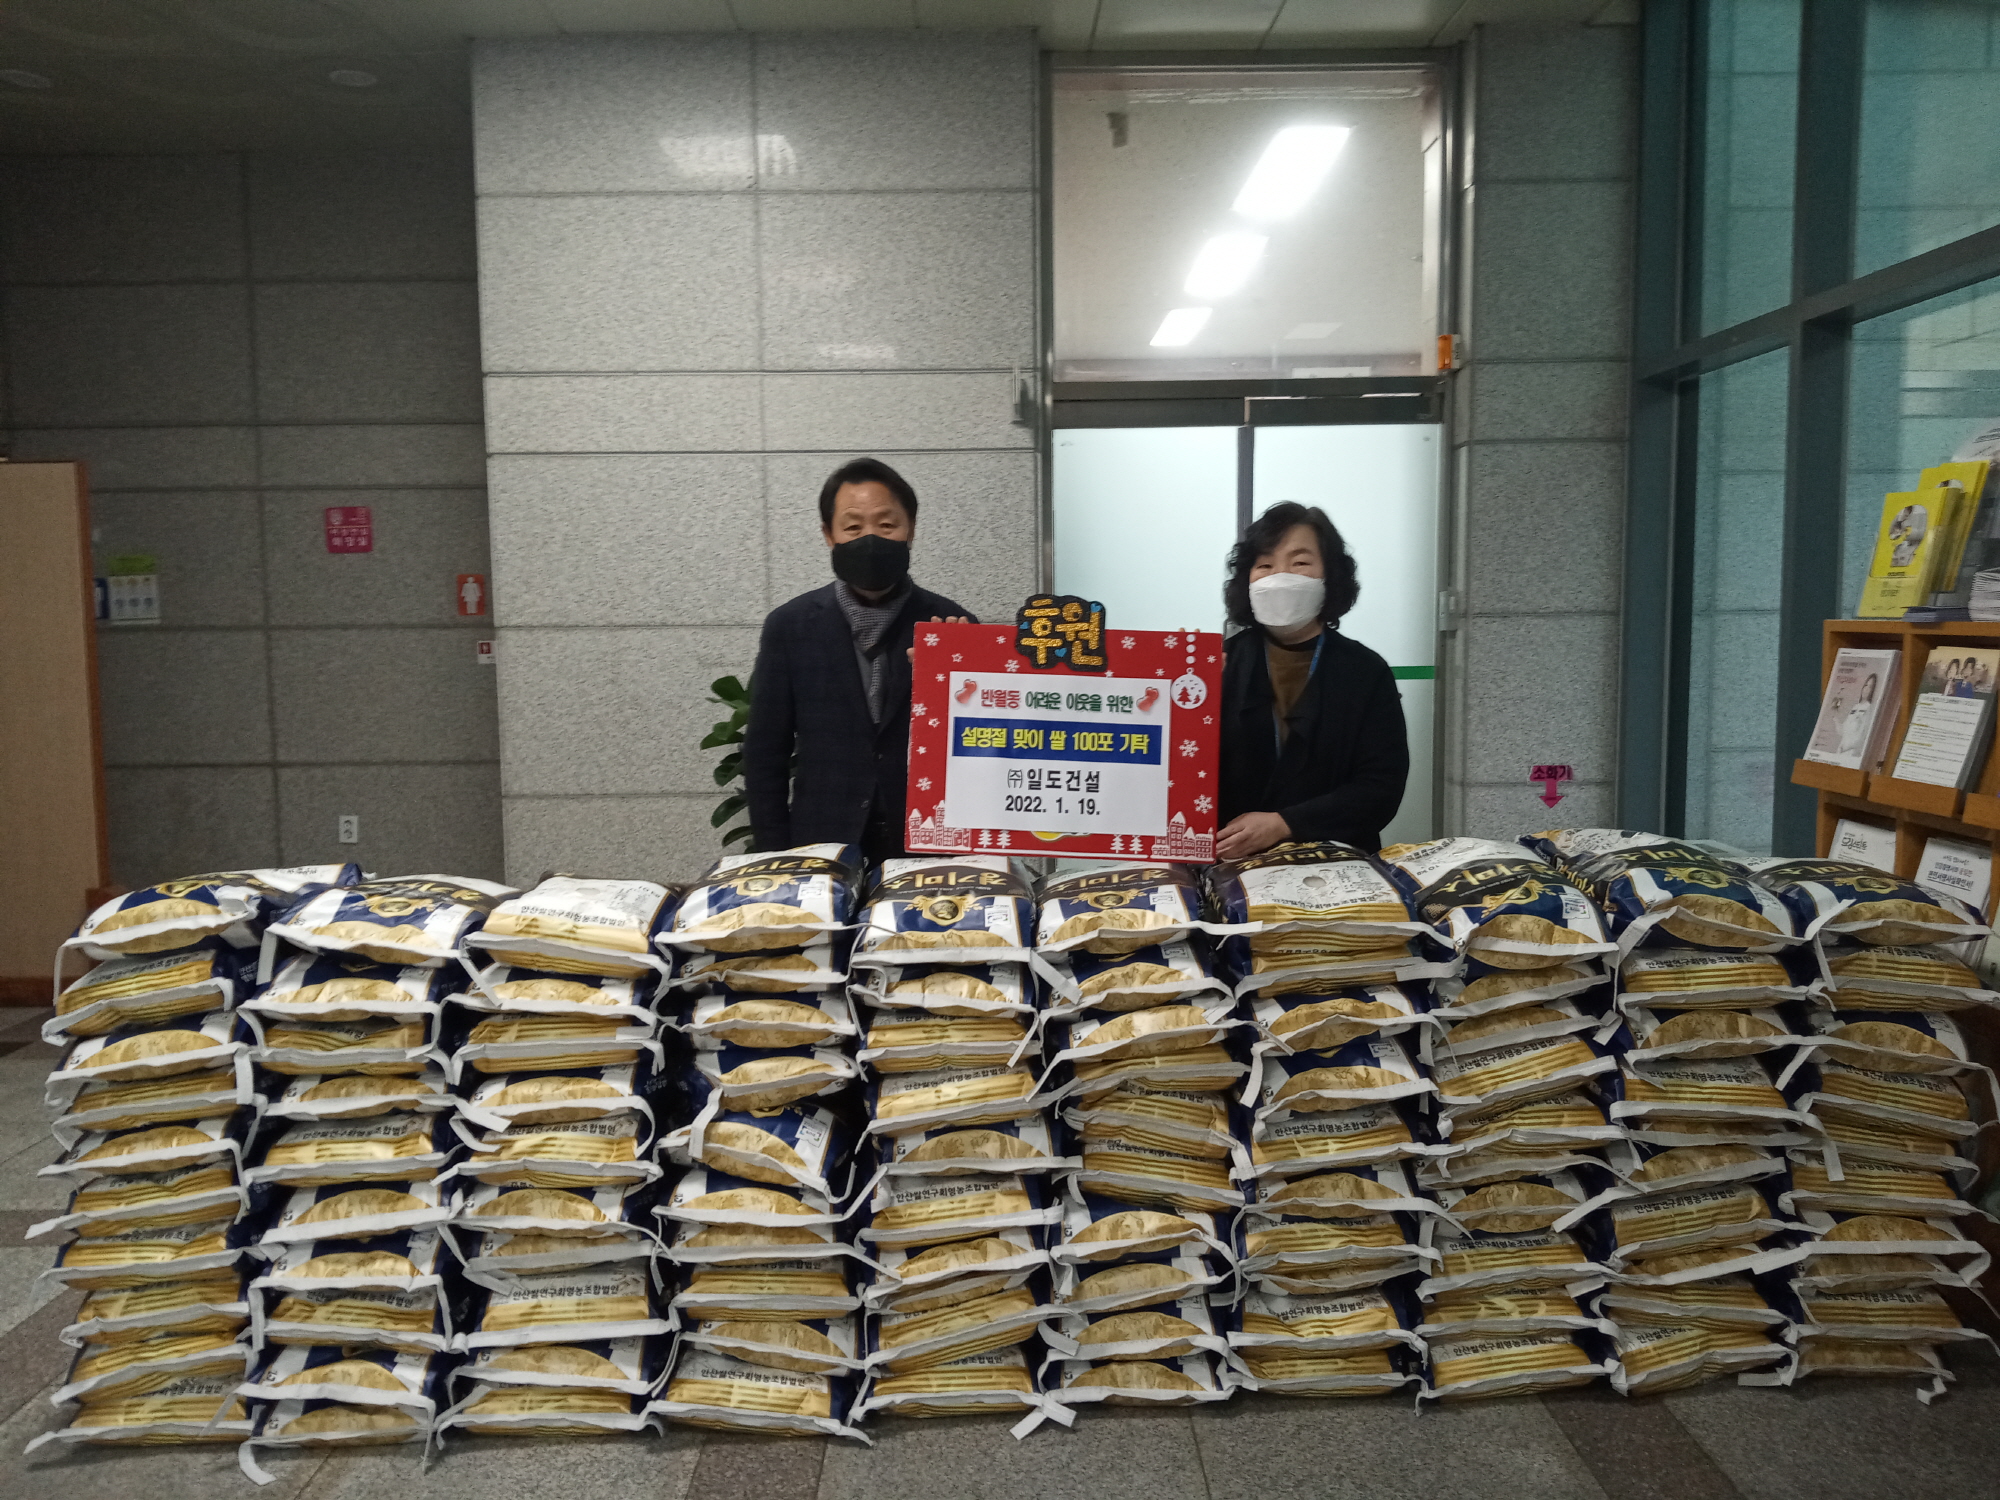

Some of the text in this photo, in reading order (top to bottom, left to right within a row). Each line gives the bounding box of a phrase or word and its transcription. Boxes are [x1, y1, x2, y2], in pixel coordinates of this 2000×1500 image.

[1020, 598, 1104, 666] 후원
[981, 688, 1134, 714] 반월동 어려운 이웃을 위한
[961, 726, 1150, 754] 설명절 맞이 쌀 100포 기탁
[1533, 766, 1572, 780] 소화기
[1005, 795, 1101, 816] 2022. 1. 19.
[884, 872, 1007, 890] 경기미소
